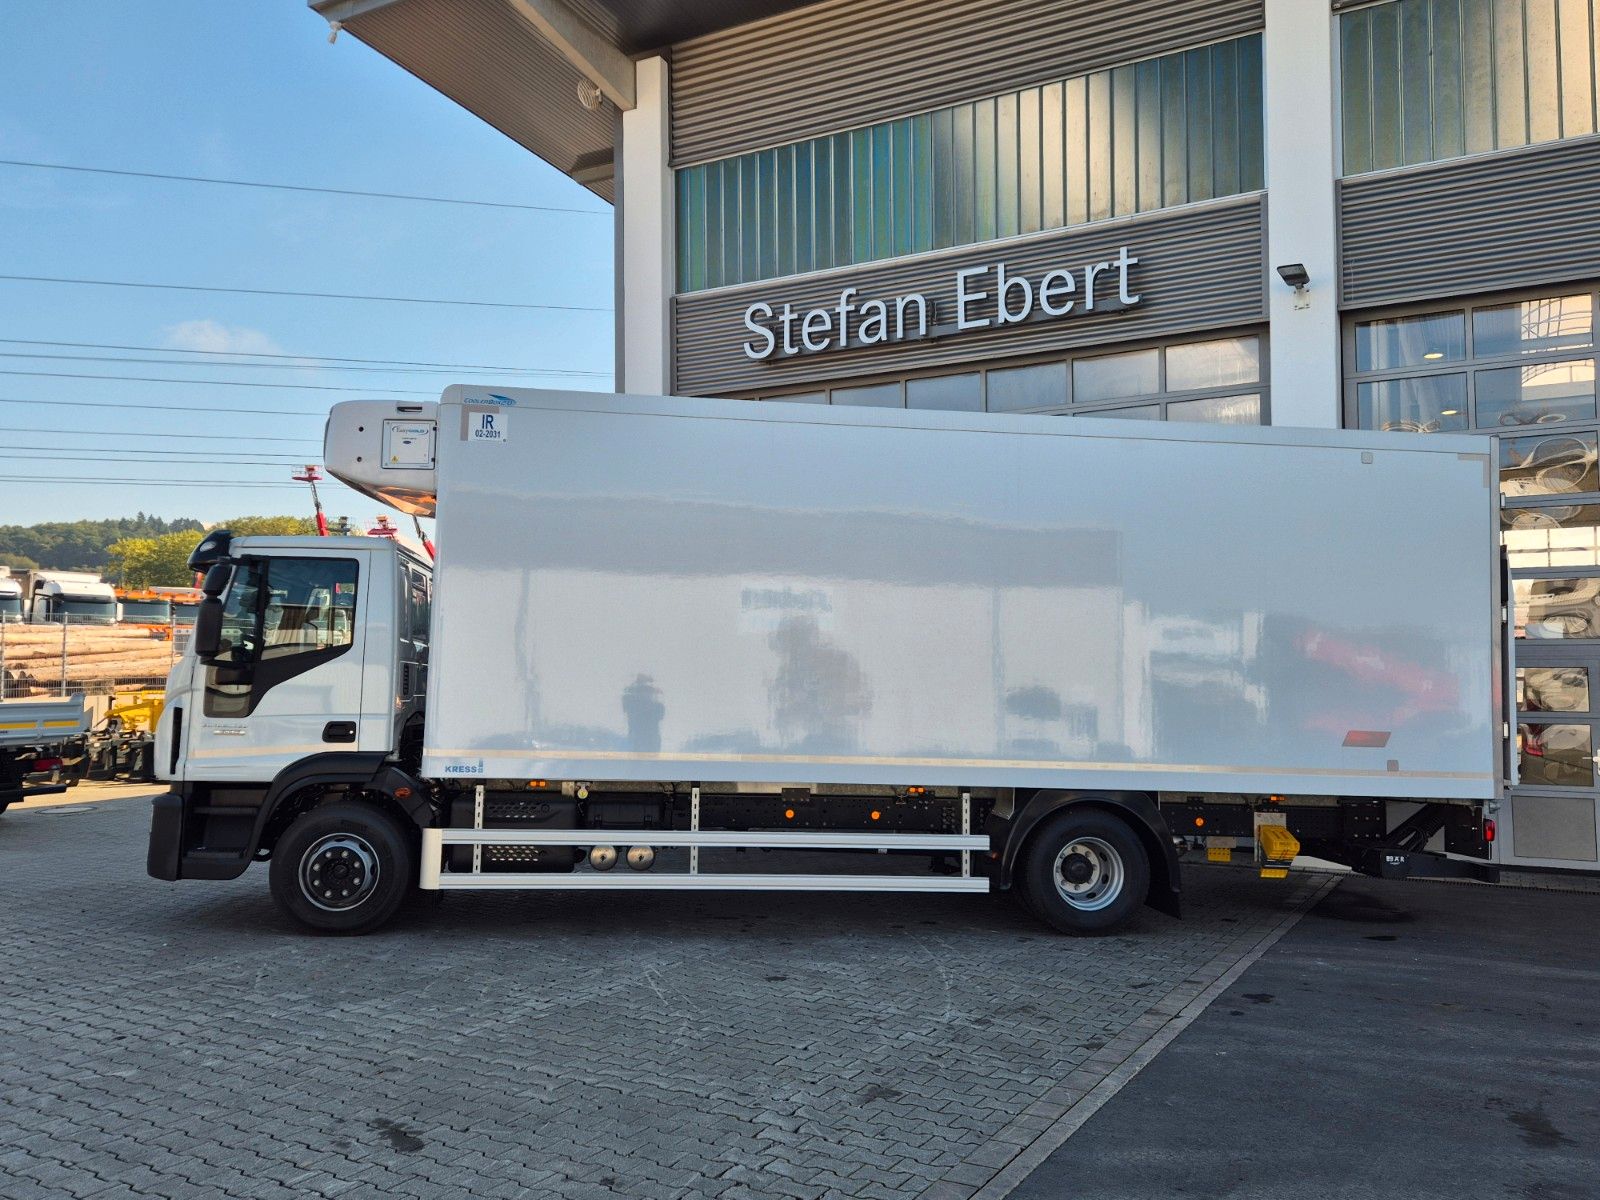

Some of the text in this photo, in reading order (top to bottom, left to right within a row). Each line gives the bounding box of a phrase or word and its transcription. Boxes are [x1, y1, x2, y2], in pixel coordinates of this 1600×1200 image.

[743, 246, 1140, 360] Stefan Ebert
[481, 414, 494, 430] IR
[474, 429, 501, 439] 02-2031
[445, 765, 477, 773] KRESS
